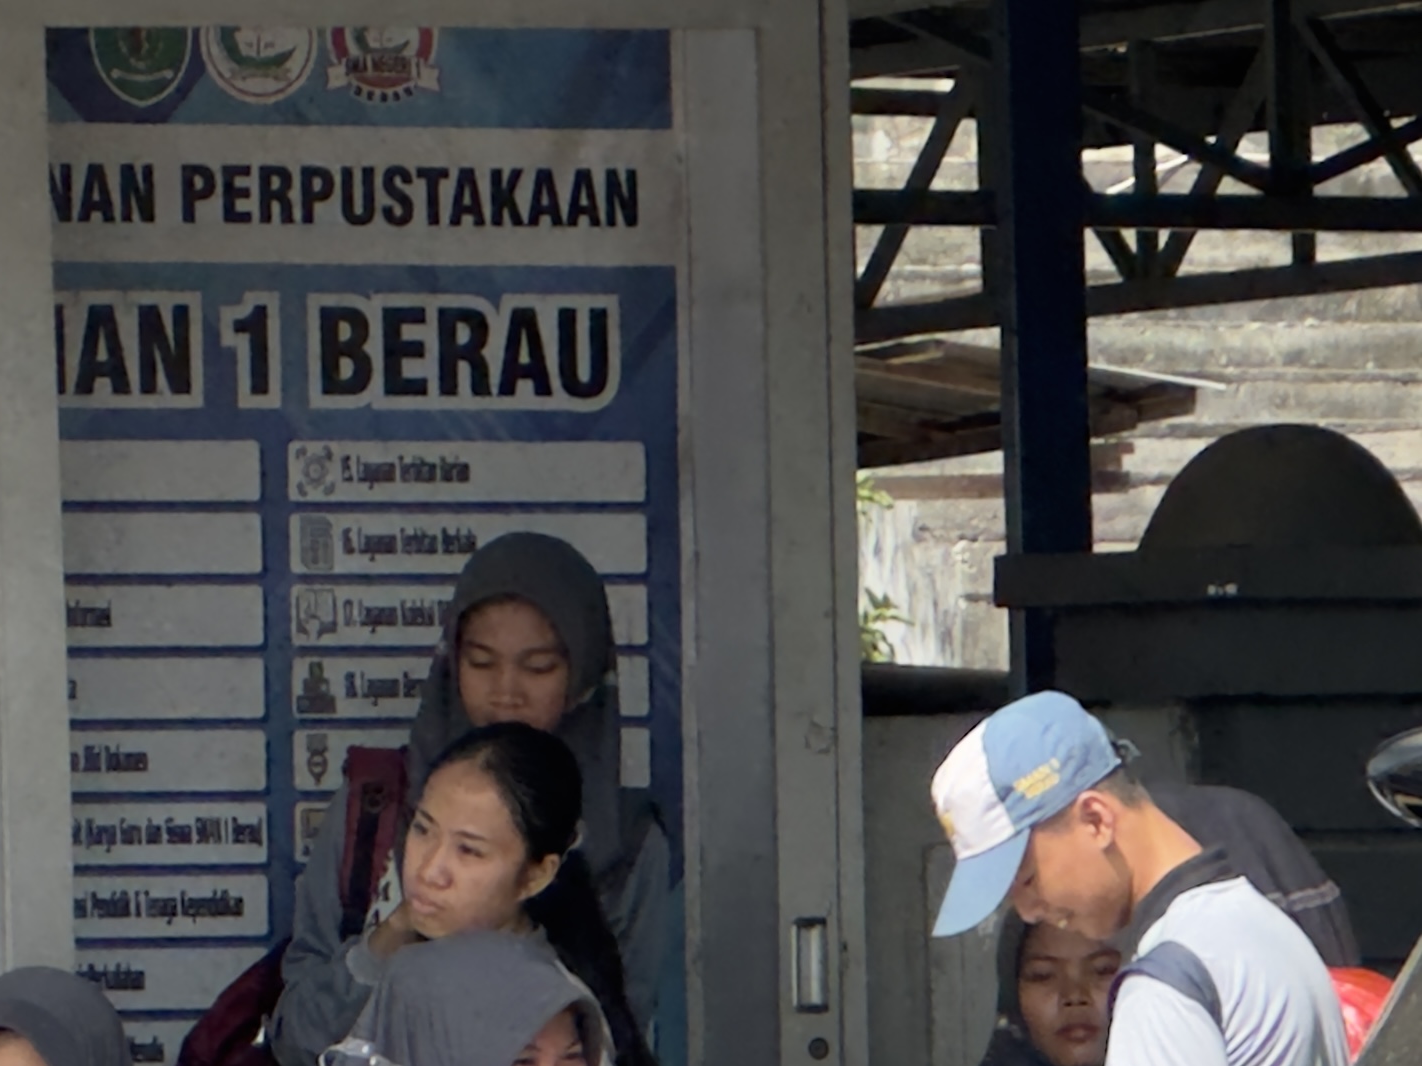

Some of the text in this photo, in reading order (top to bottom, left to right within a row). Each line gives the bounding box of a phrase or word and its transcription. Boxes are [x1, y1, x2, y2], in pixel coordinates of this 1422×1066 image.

[180, 163, 639, 228] PERPUSTAKAAN
[232, 303, 270, 395] 1
[319, 304, 612, 399] BERAU
